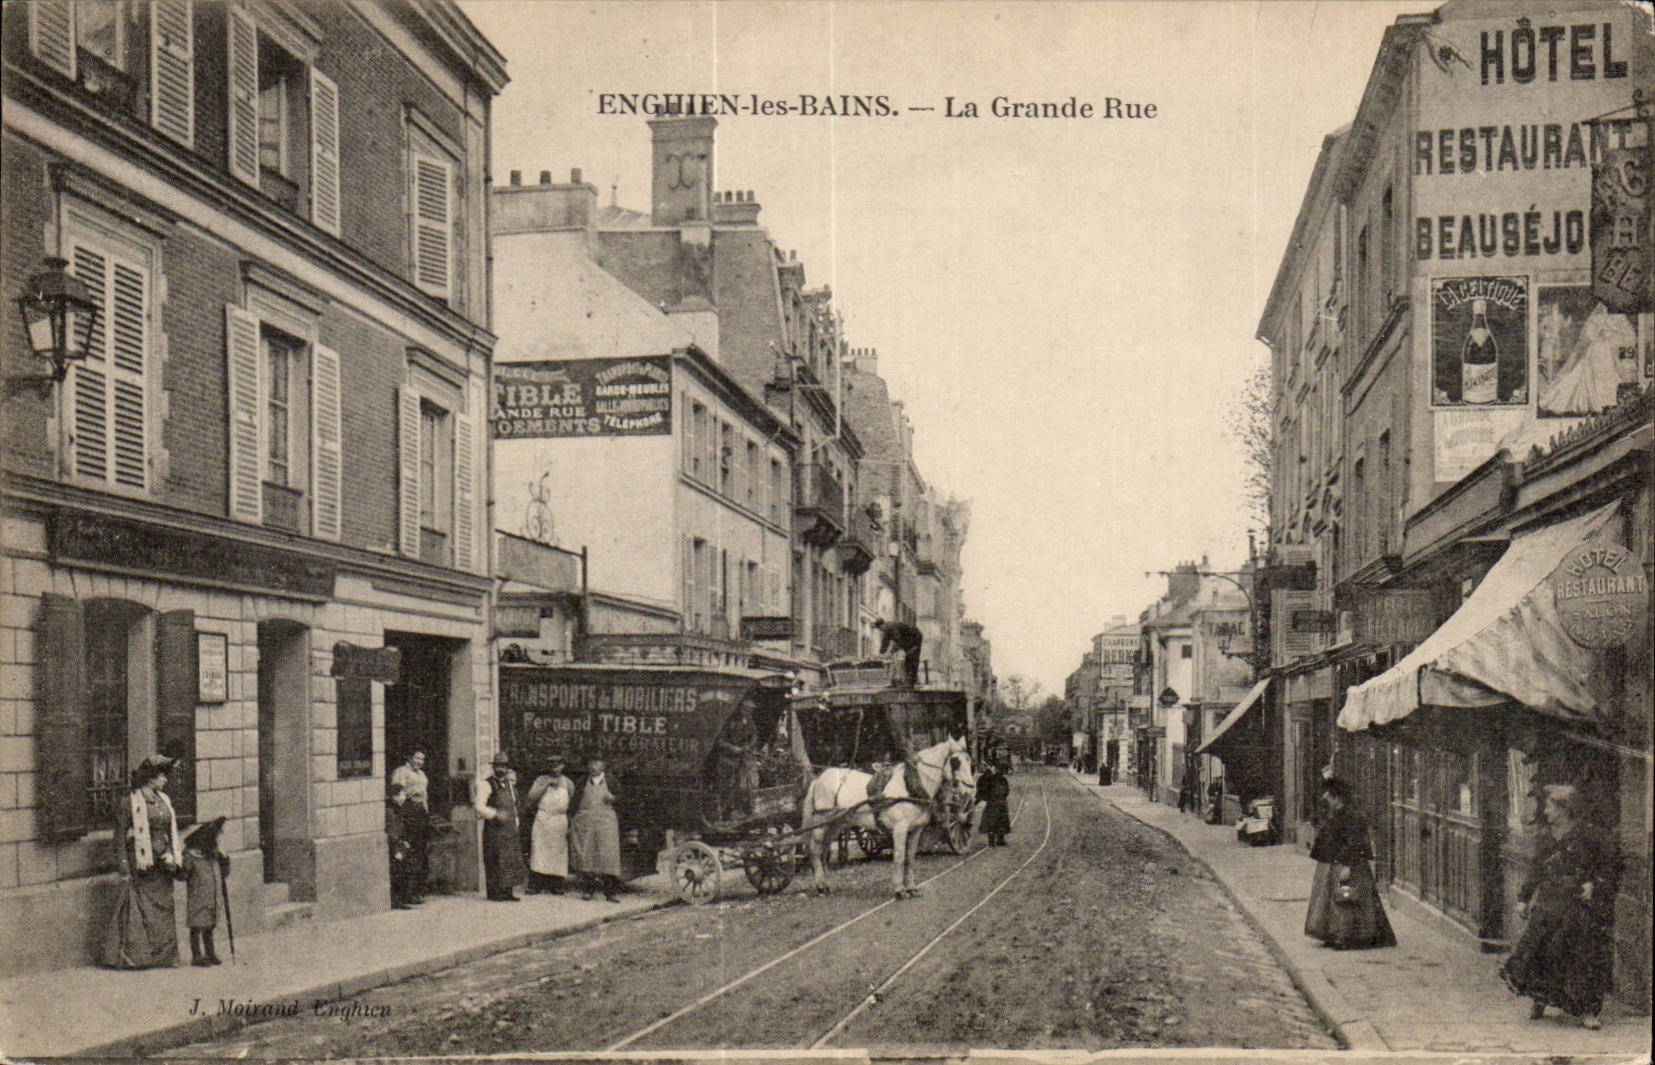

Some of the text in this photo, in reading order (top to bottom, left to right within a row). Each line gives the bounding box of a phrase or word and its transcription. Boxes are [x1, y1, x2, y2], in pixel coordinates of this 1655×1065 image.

[1480, 17, 1628, 85] HÔTEL
[1415, 122, 1632, 176] RESTAURANT
[549, 406, 587, 419] RUE
[1557, 575, 1645, 599] RESTAURANT
[612, 686, 698, 712] MOBILIERS
[523, 710, 668, 734] Fernand TIBLE
